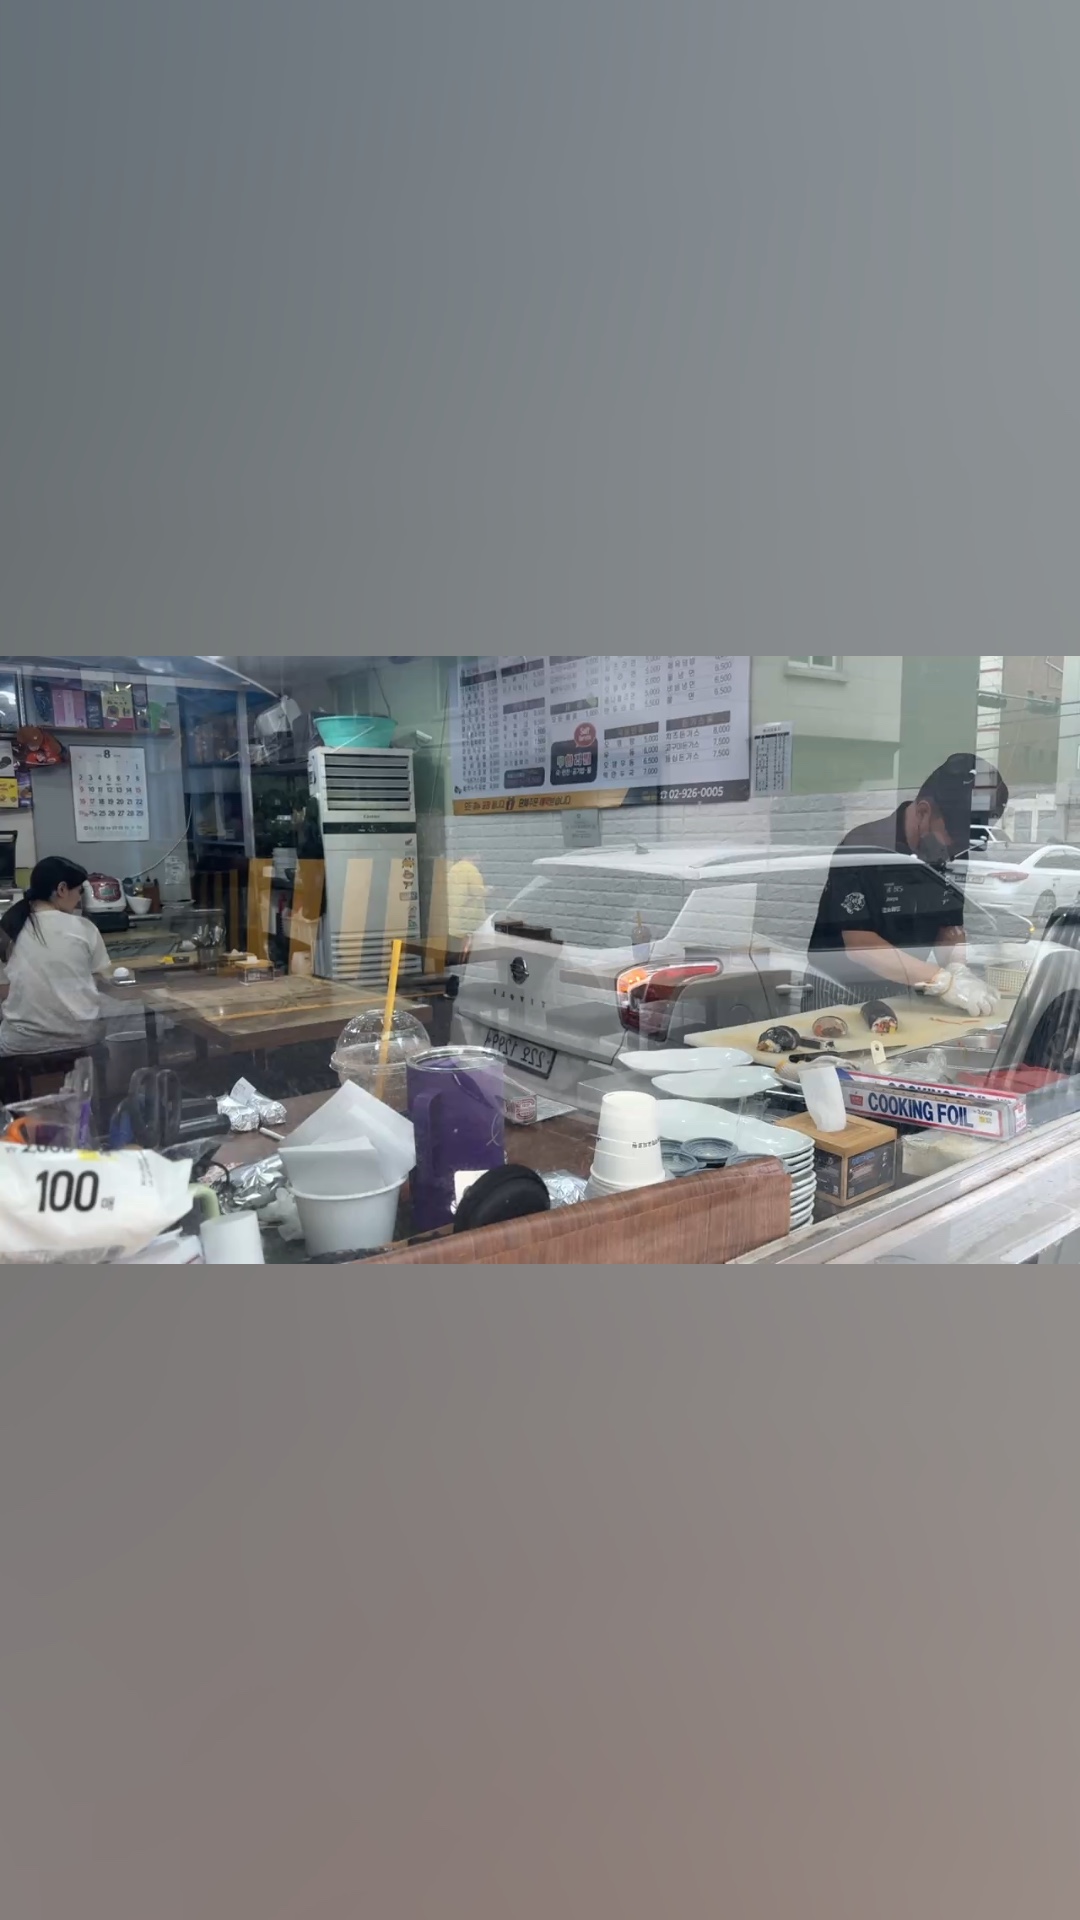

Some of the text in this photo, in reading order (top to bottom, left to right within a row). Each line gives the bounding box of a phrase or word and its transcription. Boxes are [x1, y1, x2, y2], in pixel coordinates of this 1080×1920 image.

[103, 749, 111, 758] 8
[669, 786, 724, 799] 02-926-0005
[868, 1092, 974, 1128] COOKING FOIL
[36, 1169, 99, 1213] 100
